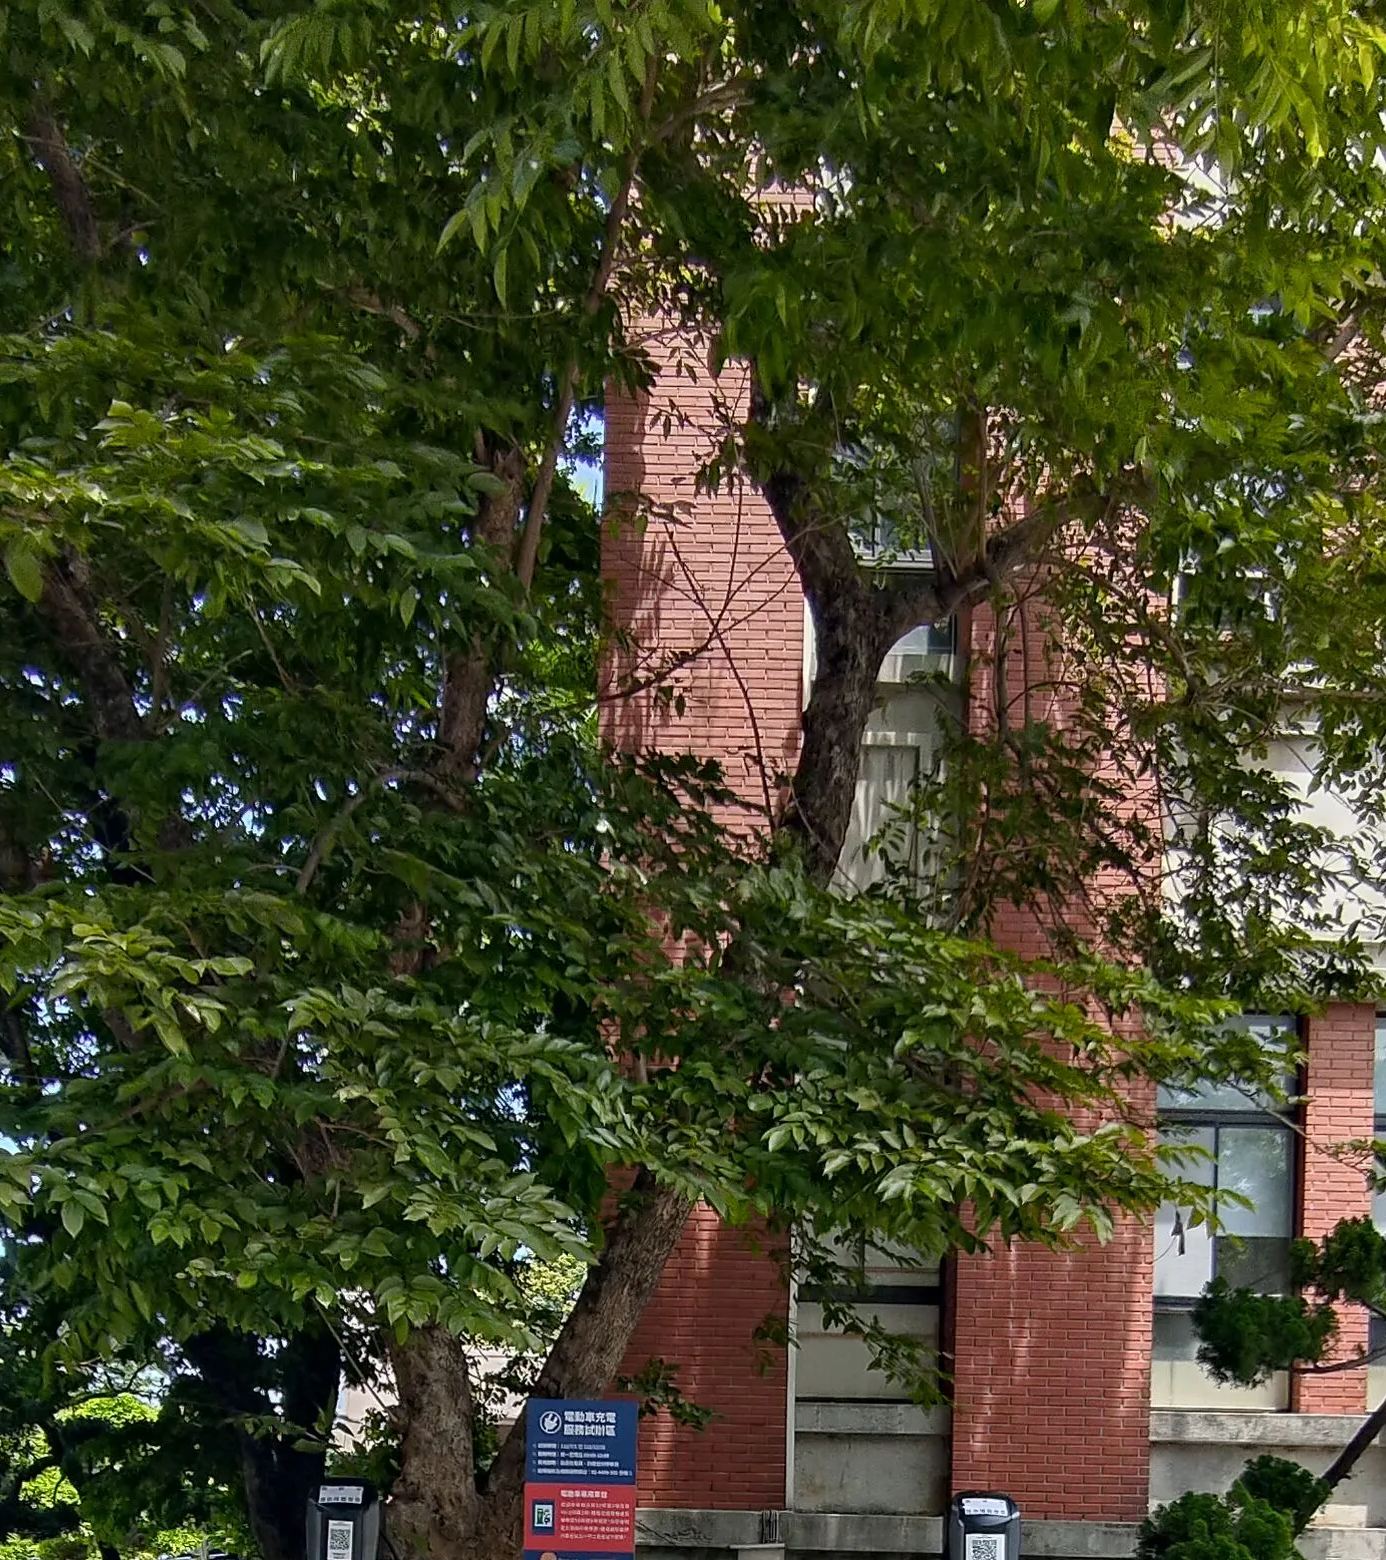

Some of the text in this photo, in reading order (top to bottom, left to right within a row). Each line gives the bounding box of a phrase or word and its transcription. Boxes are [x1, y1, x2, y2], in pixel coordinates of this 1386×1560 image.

[564, 1411, 616, 1424] 電動車充電
